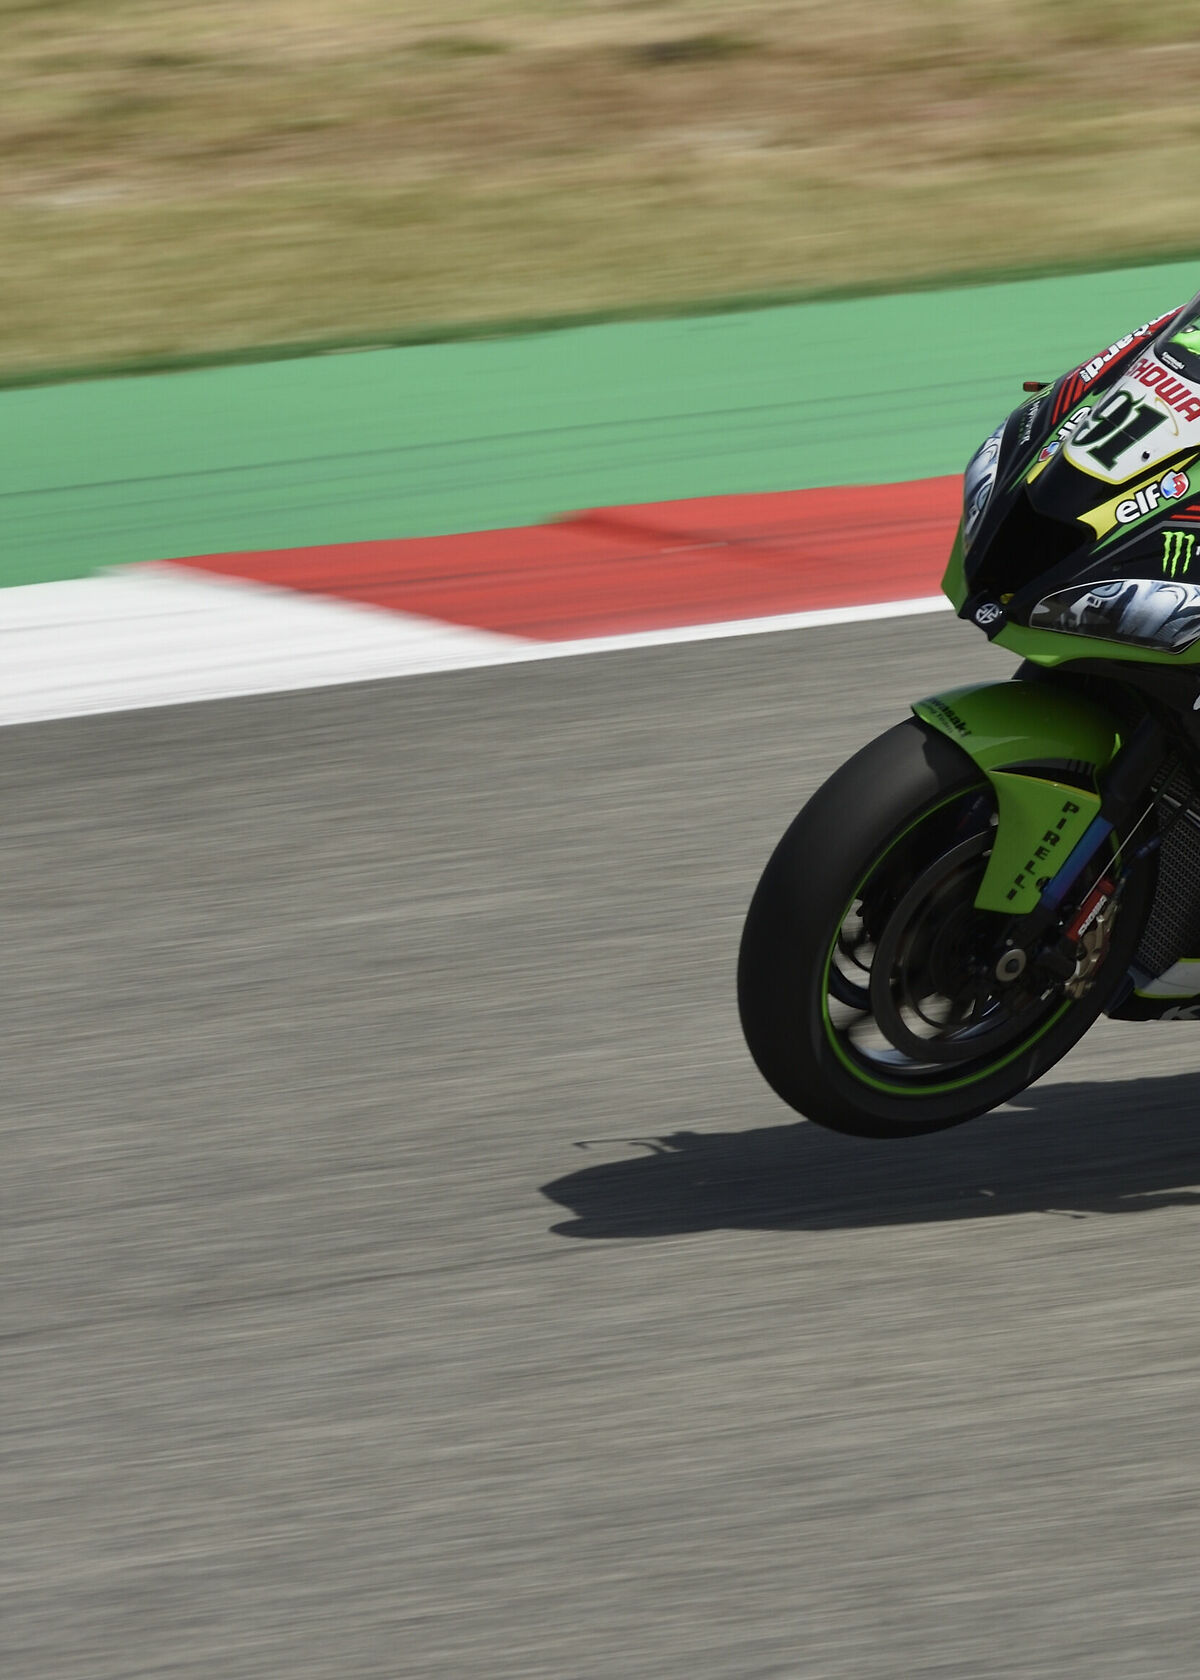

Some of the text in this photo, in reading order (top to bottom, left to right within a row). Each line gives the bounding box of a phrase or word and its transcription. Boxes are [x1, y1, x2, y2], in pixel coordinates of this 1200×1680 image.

[1071, 388, 1169, 470] 91
[1115, 481, 1161, 525] elf
[1006, 801, 1080, 900] PIRELLI
